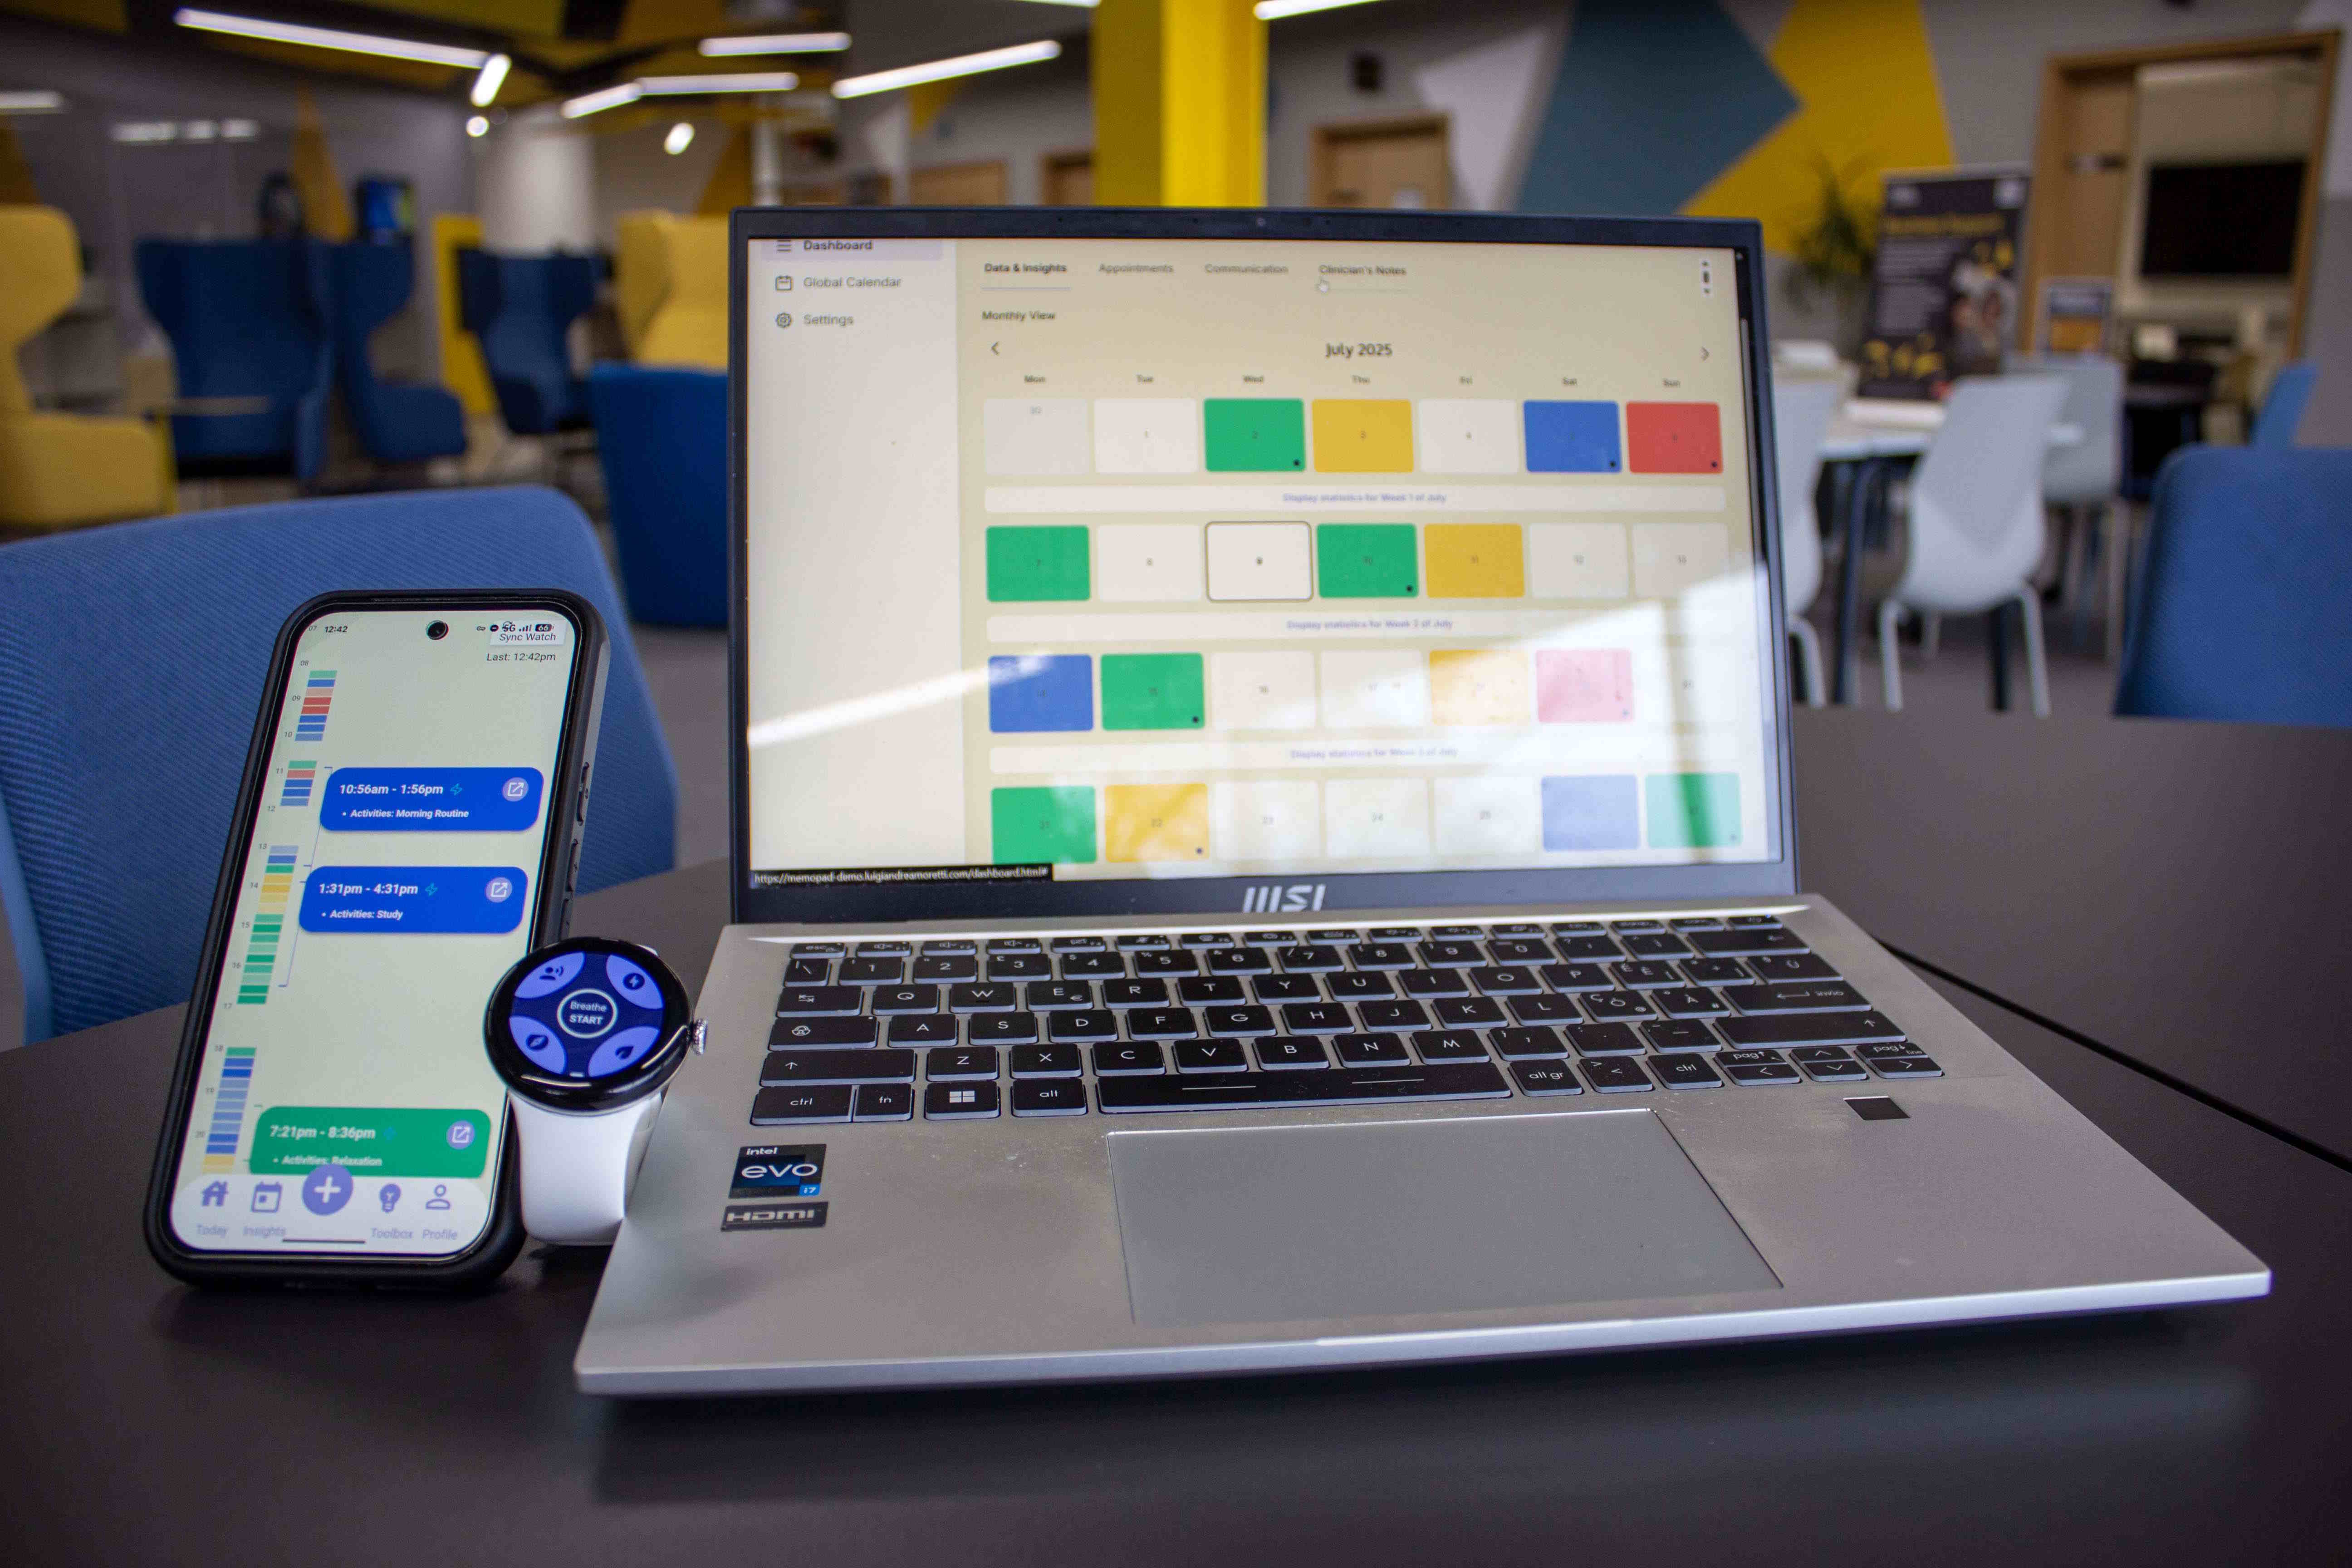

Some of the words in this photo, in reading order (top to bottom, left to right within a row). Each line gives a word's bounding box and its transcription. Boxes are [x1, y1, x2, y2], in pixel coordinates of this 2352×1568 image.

[804, 240, 873, 251] Dashboard
[984, 263, 1010, 273] Data
[1013, 264, 1020, 273] &
[1023, 263, 1067, 274] Insights
[1099, 263, 1174, 274] Appointments
[1205, 264, 1289, 274] Communication
[1318, 265, 1373, 274] Clinician's
[1376, 265, 1406, 275] Notes
[804, 276, 843, 288] Global
[846, 276, 902, 288] Calendar
[804, 314, 853, 326] Settings
[982, 311, 1025, 322] Monthly
[1030, 311, 1056, 320] View
[1325, 343, 1353, 358] July
[1357, 343, 1393, 356] 2025
[1024, 375, 1046, 383] Mon
[1137, 375, 1154, 383] Tue
[1243, 375, 1264, 383] Wed
[499, 633, 523, 643] Sync
[526, 633, 556, 641] Watch
[486, 653, 510, 661] Last:
[514, 652, 556, 662] 12:42pm
[340, 784, 389, 794] 10:56am
[401, 784, 443, 797] 1:56pm
[350, 809, 394, 818] Activities:
[396, 809, 433, 820] Morning
[435, 809, 469, 818] Routine
[319, 883, 363, 896] 1:31pm
[373, 883, 418, 897] 4:31pm
[330, 910, 375, 919] Activities:
[377, 910, 403, 921] Study
[1088, 958, 1099, 966] 4
[1496, 973, 1514, 982] O
[1279, 981, 1291, 990] Y
[1352, 978, 1367, 987] U
[1053, 987, 1064, 996] E
[1129, 985, 1141, 994] R
[1204, 983, 1216, 992] T
[897, 992, 915, 1000] Q
[971, 989, 994, 998] W
[570, 1001, 607, 1012] Breathe
[1462, 1005, 1477, 1014] K
[1537, 1002, 1552, 1011] L
[1310, 1011, 1325, 1020] H
[1389, 1009, 1400, 1017] J
[569, 1014, 603, 1025] START
[1155, 1016, 1166, 1025] F
[1230, 1014, 1249, 1022] G
[916, 1023, 930, 1032] A
[998, 1021, 1009, 1029] S
[1075, 1019, 1089, 1027] D
[1363, 1042, 1379, 1052] N
[1443, 1039, 1460, 1049] M
[1201, 1048, 1217, 1057] V
[1284, 1045, 1298, 1054] B
[1873, 1045, 1898, 1054] pag
[1039, 1053, 1052, 1062] X
[1120, 1050, 1136, 1059] C
[1733, 1052, 1759, 1061] pag
[957, 1056, 970, 1065] Z
[1676, 1063, 1697, 1072] ctrl
[1529, 1071, 1548, 1079] alt
[1550, 1071, 1564, 1081] gr
[1039, 1089, 1058, 1098] alt
[790, 1097, 813, 1106] ctrl
[270, 1126, 317, 1139] 7:21pm
[328, 1127, 376, 1141] 8:36pm
[746, 1147, 779, 1155] intel
[332, 1156, 382, 1166] Relaxation
[741, 1163, 818, 1178] evo
[726, 1209, 814, 1222] HDMI
[196, 1225, 229, 1238] Today
[243, 1226, 286, 1238] Insights
[371, 1228, 414, 1240] Toolbox
[422, 1229, 458, 1240] Profile
